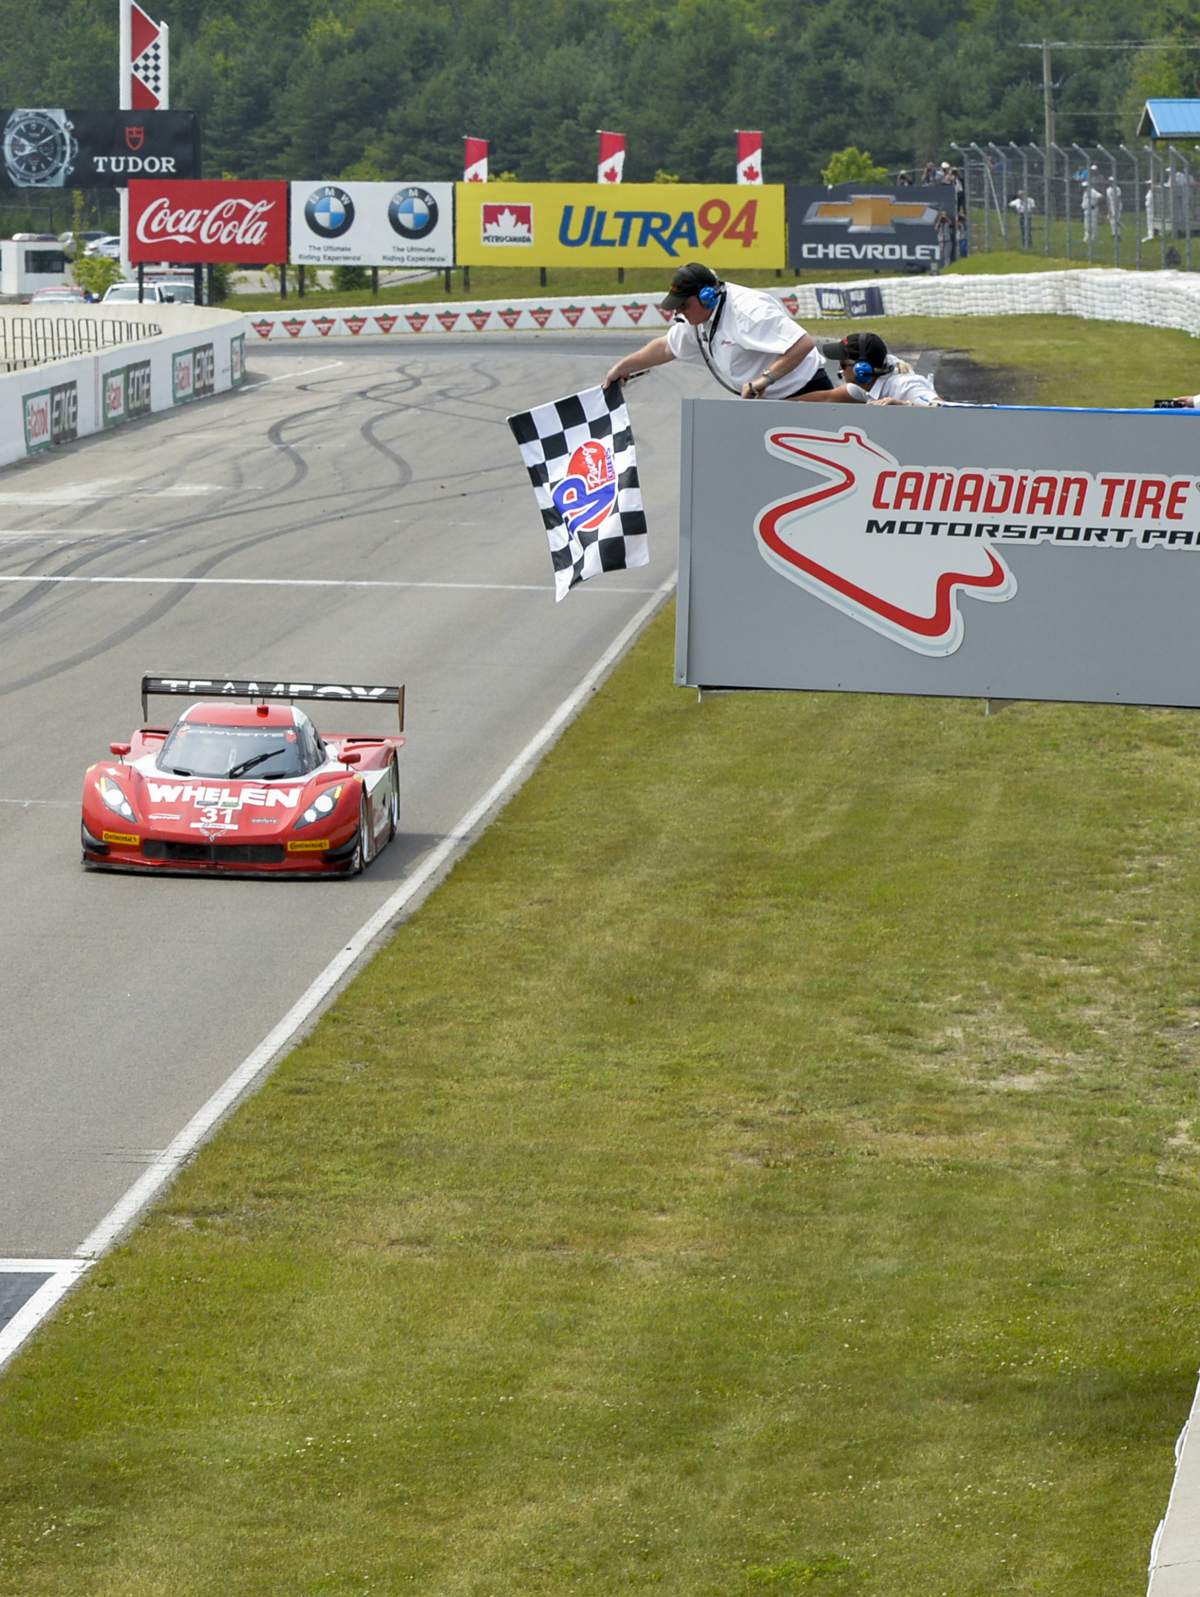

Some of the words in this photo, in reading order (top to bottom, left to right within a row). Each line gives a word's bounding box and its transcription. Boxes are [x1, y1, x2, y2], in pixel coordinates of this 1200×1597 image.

[93, 156, 176, 173] TUDOR
[136, 197, 276, 245] Coca-Cola
[558, 205, 698, 256] ULTRA
[697, 198, 759, 249] 94
[802, 243, 941, 260] CHEVROLET
[872, 470, 1089, 517] CANADIAN
[1100, 477, 1191, 520] TIRE
[865, 519, 1133, 543] MOTORSPORT
[1142, 528, 1200, 546] PA
[146, 783, 304, 808] WHELEN
[201, 807, 233, 824] 31
